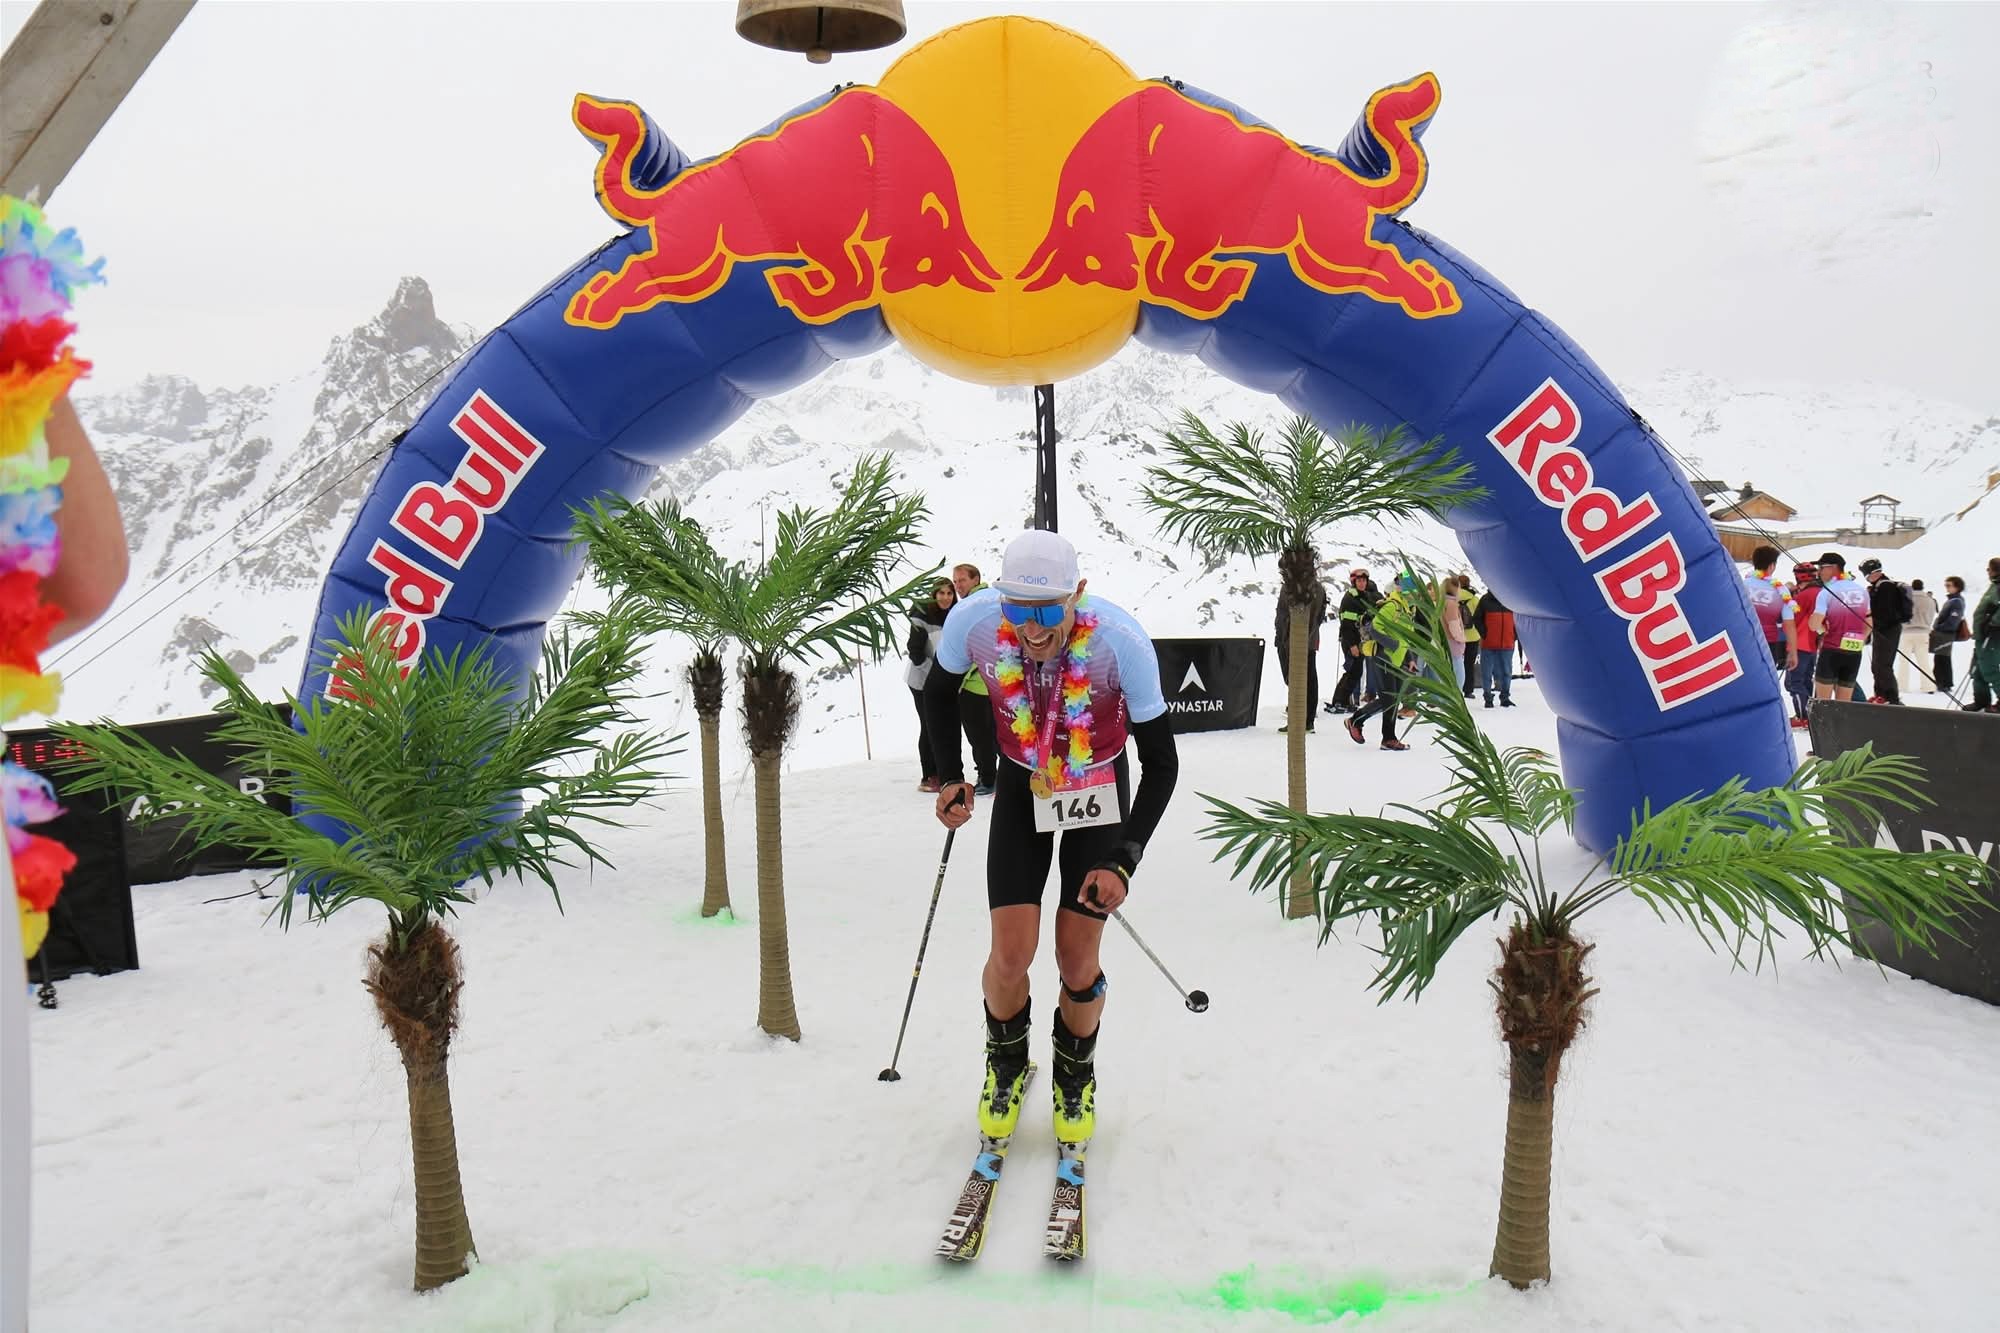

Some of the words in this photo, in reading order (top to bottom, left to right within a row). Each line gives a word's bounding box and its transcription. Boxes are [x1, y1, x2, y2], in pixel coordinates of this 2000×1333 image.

[391, 389, 545, 570] Bull
[1487, 378, 1661, 562] Red
[1594, 532, 1743, 711] Bull
[1167, 699, 1224, 713] YNASTAR
[1051, 794, 1102, 822] 146
